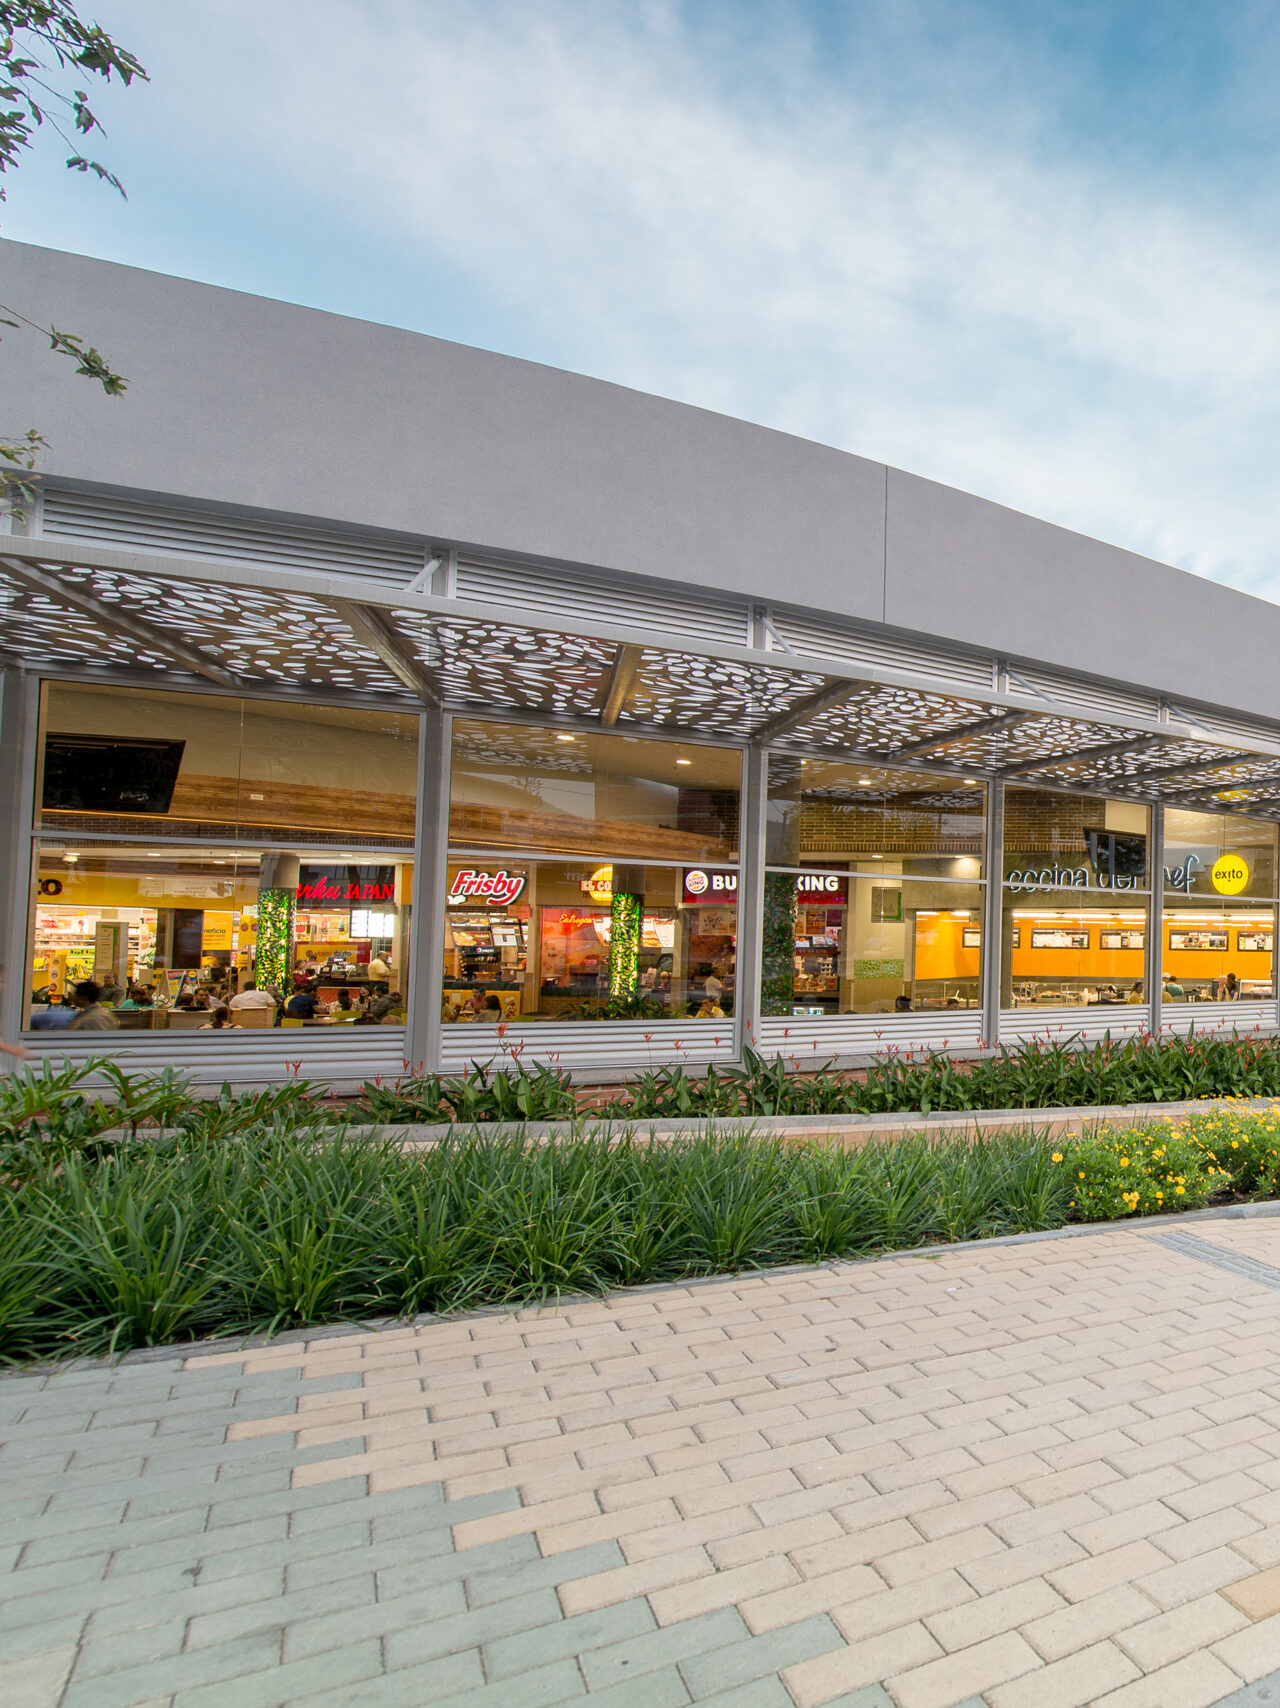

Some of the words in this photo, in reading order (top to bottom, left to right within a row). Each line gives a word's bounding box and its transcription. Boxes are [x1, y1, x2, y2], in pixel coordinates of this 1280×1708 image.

[451, 870, 524, 905] Frisby
[581, 881, 595, 892] EL
[597, 881, 612, 892] CO
[1008, 862, 1089, 893] cocina
[343, 884, 394, 899] JAPAN
